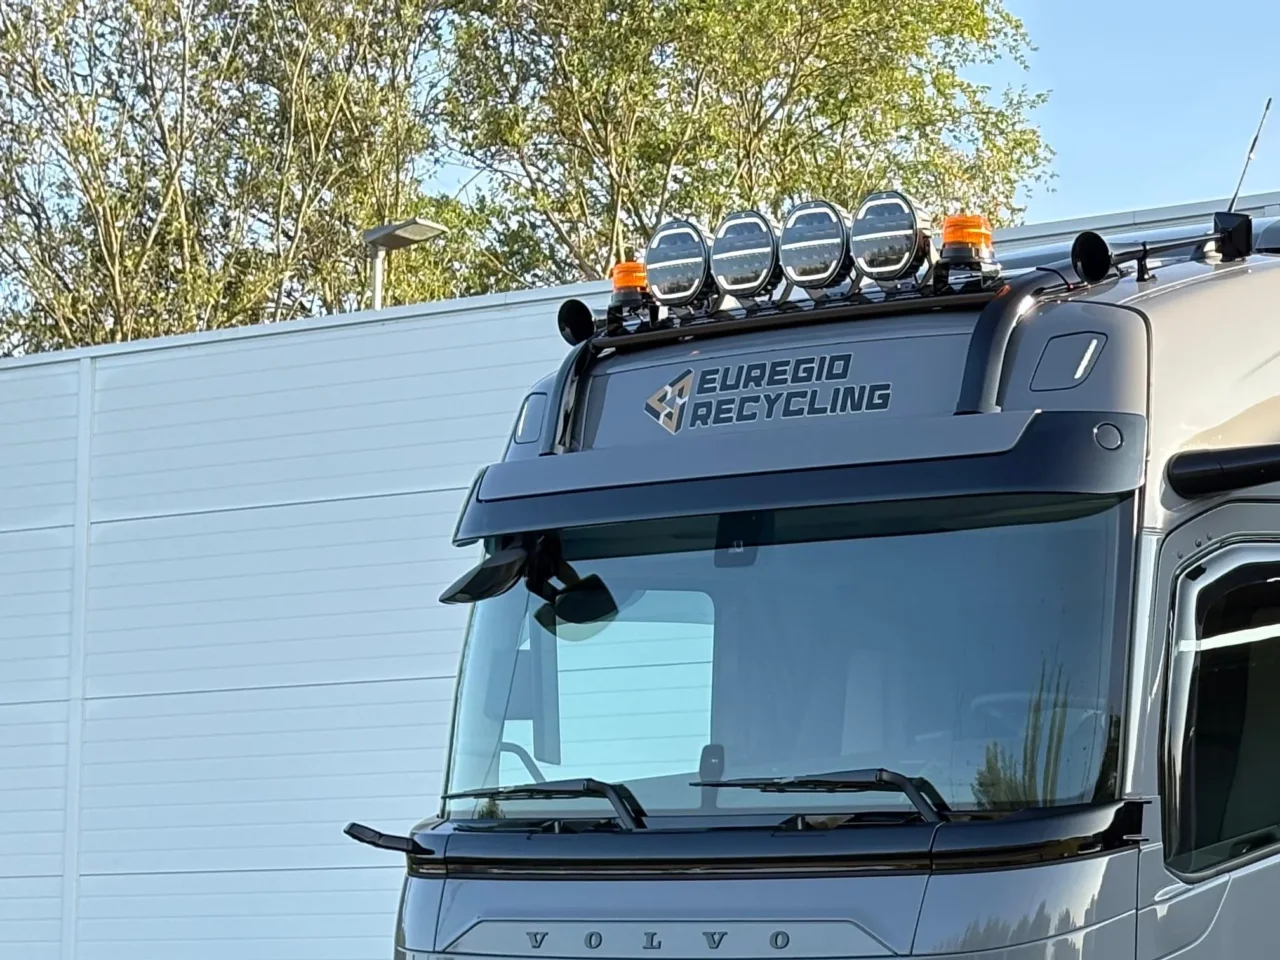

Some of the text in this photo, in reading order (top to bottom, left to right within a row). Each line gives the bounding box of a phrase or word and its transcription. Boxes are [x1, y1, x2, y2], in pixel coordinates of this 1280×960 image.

[695, 352, 853, 396] EUREGIO
[688, 382, 892, 429] RECYCLING
[525, 930, 791, 950] VOLVO
